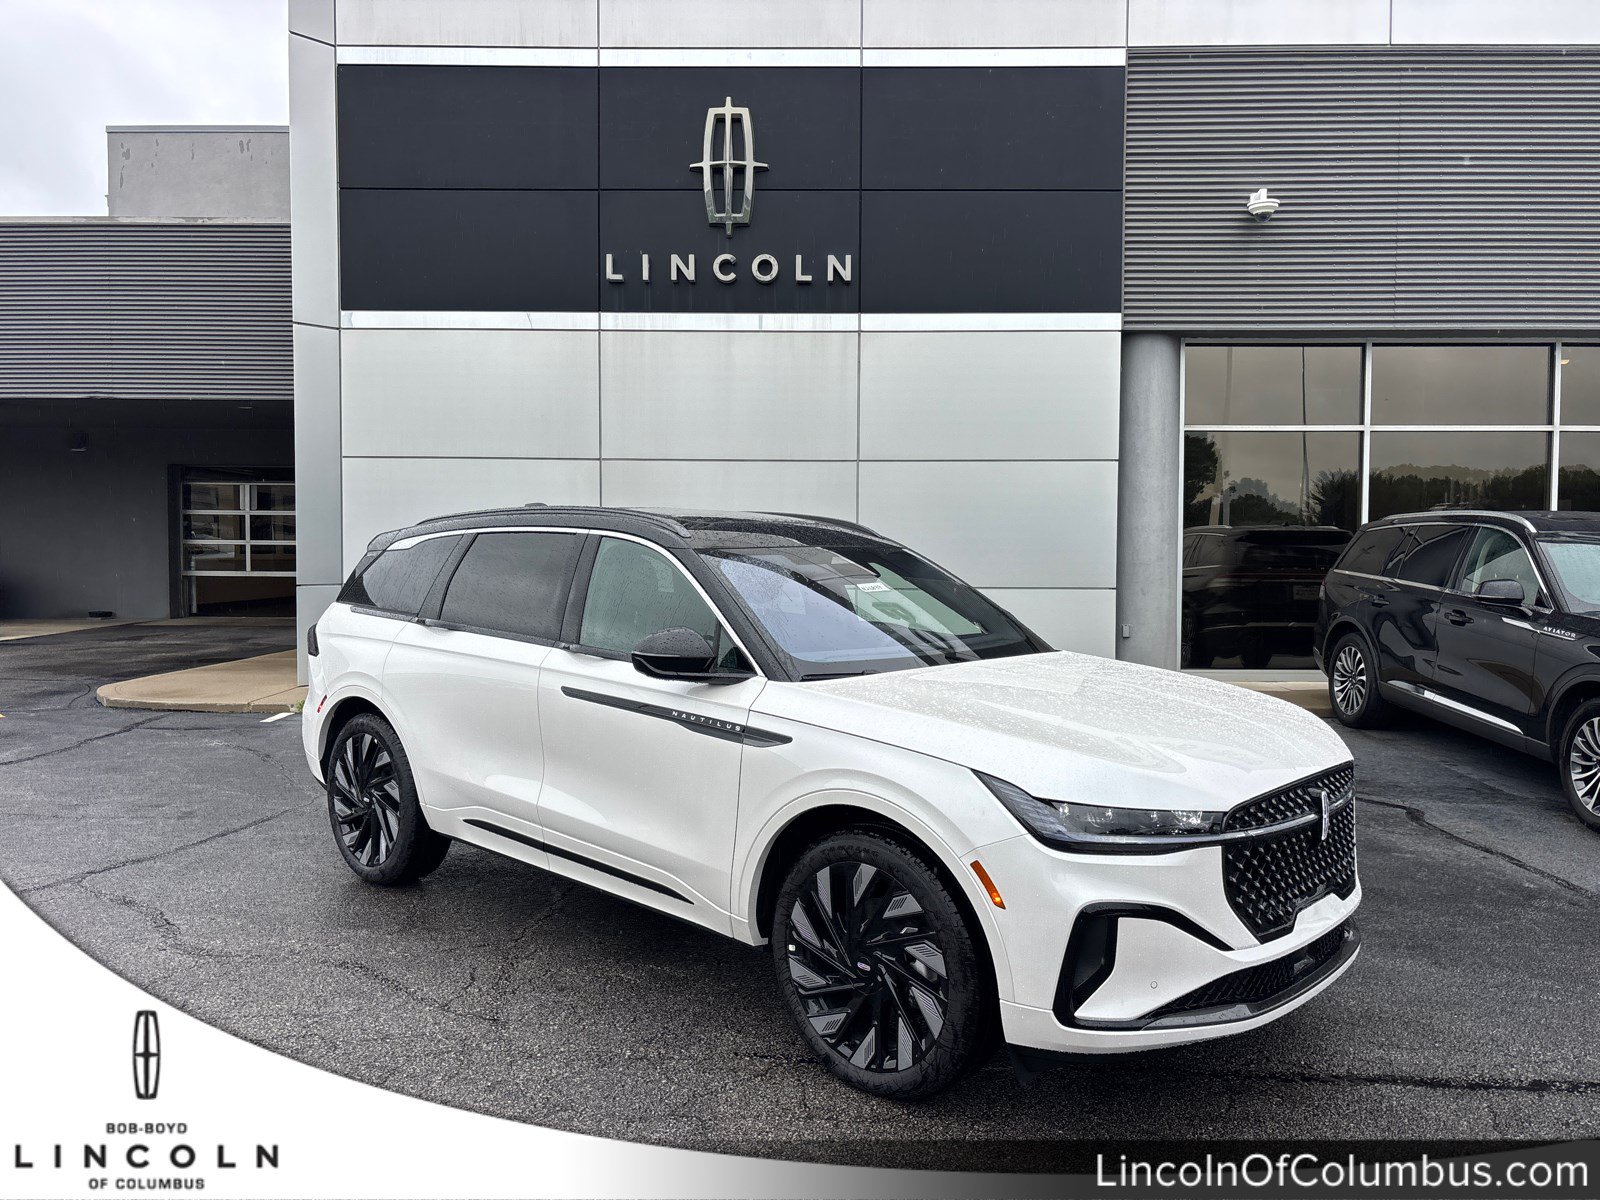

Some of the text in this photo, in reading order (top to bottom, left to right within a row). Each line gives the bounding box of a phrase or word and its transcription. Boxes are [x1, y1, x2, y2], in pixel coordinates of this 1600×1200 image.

[605, 253, 852, 284] LINCOLN
[1543, 626, 1576, 638] AVIATOR
[672, 711, 740, 731] NAUTILUS
